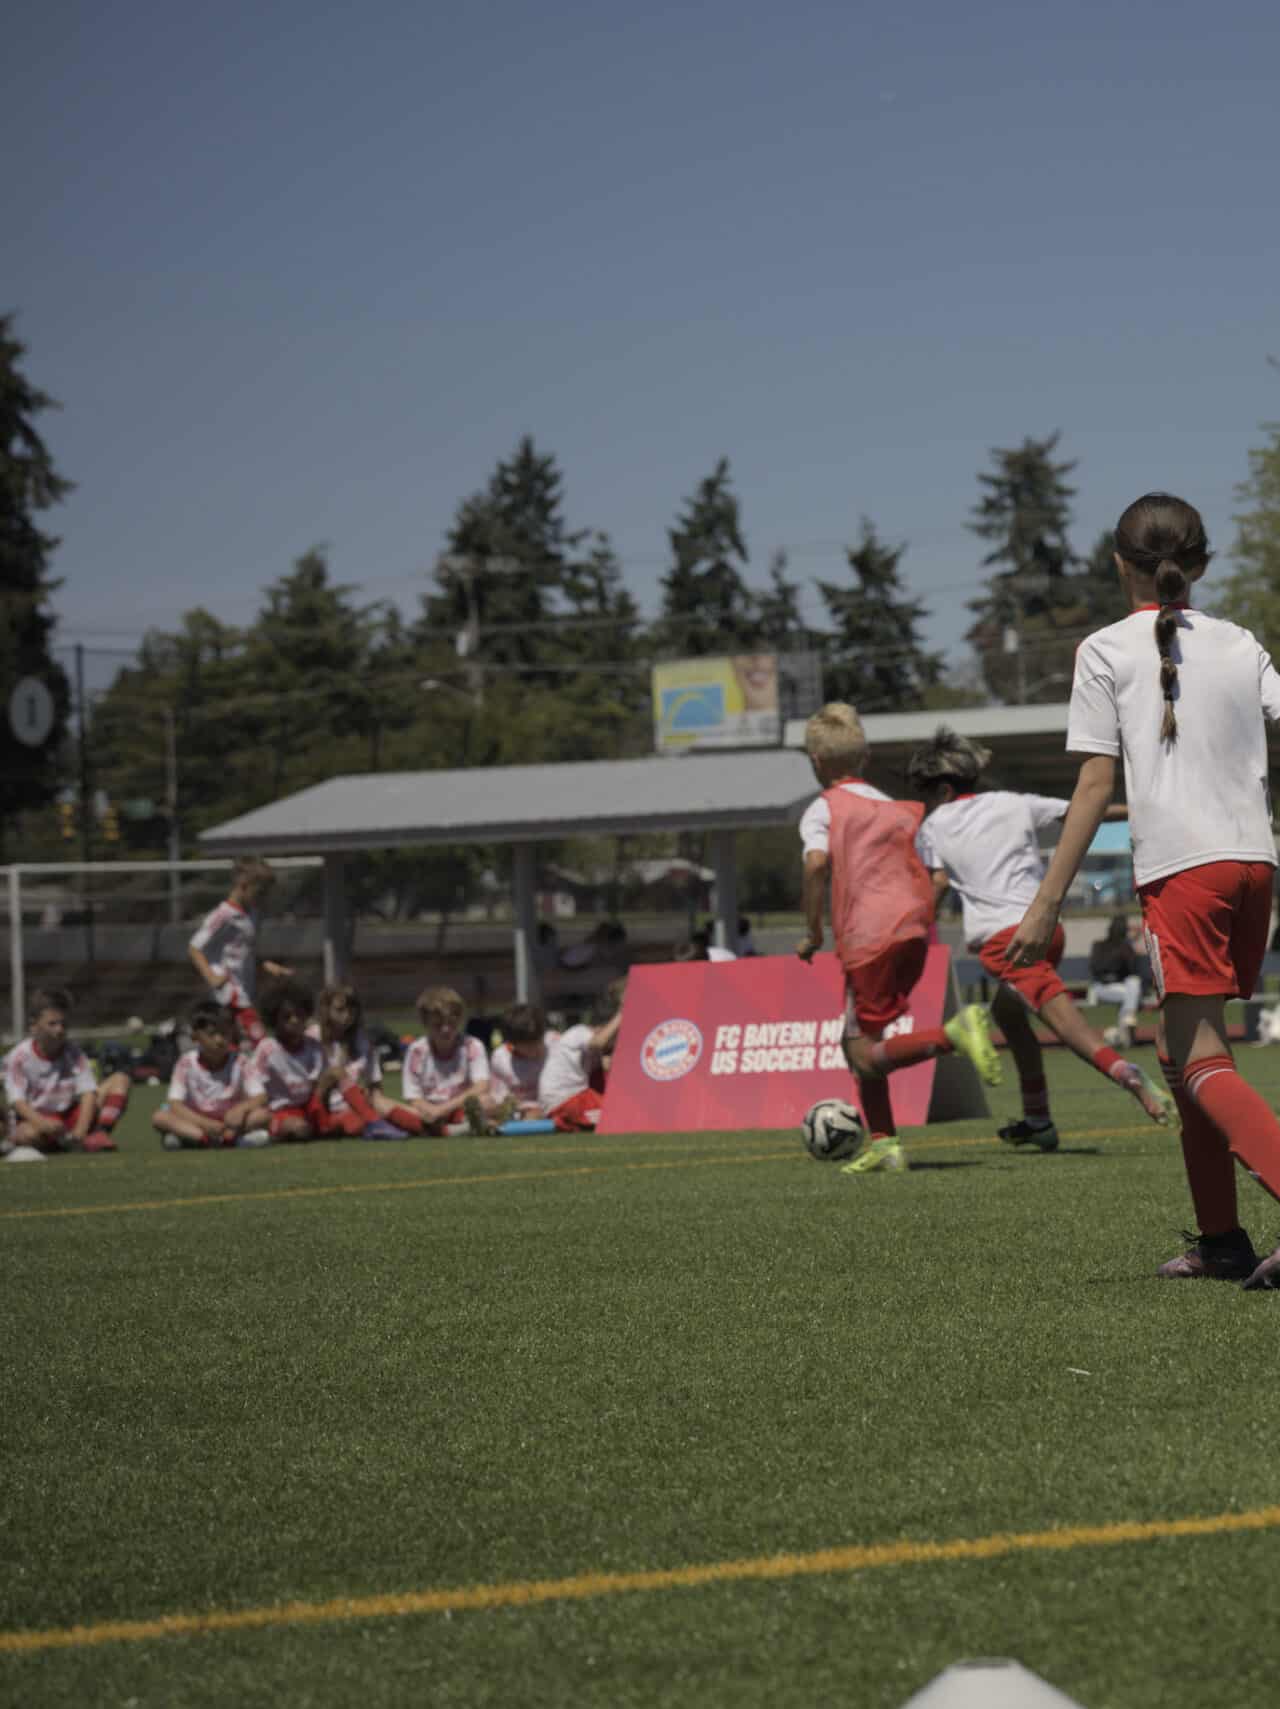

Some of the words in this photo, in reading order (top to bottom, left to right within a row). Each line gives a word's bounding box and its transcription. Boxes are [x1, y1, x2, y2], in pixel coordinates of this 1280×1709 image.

[714, 1024, 742, 1049] FC
[743, 1021, 818, 1047] BAYERN
[711, 1051, 738, 1075] US
[740, 1047, 817, 1073] SOCCER
